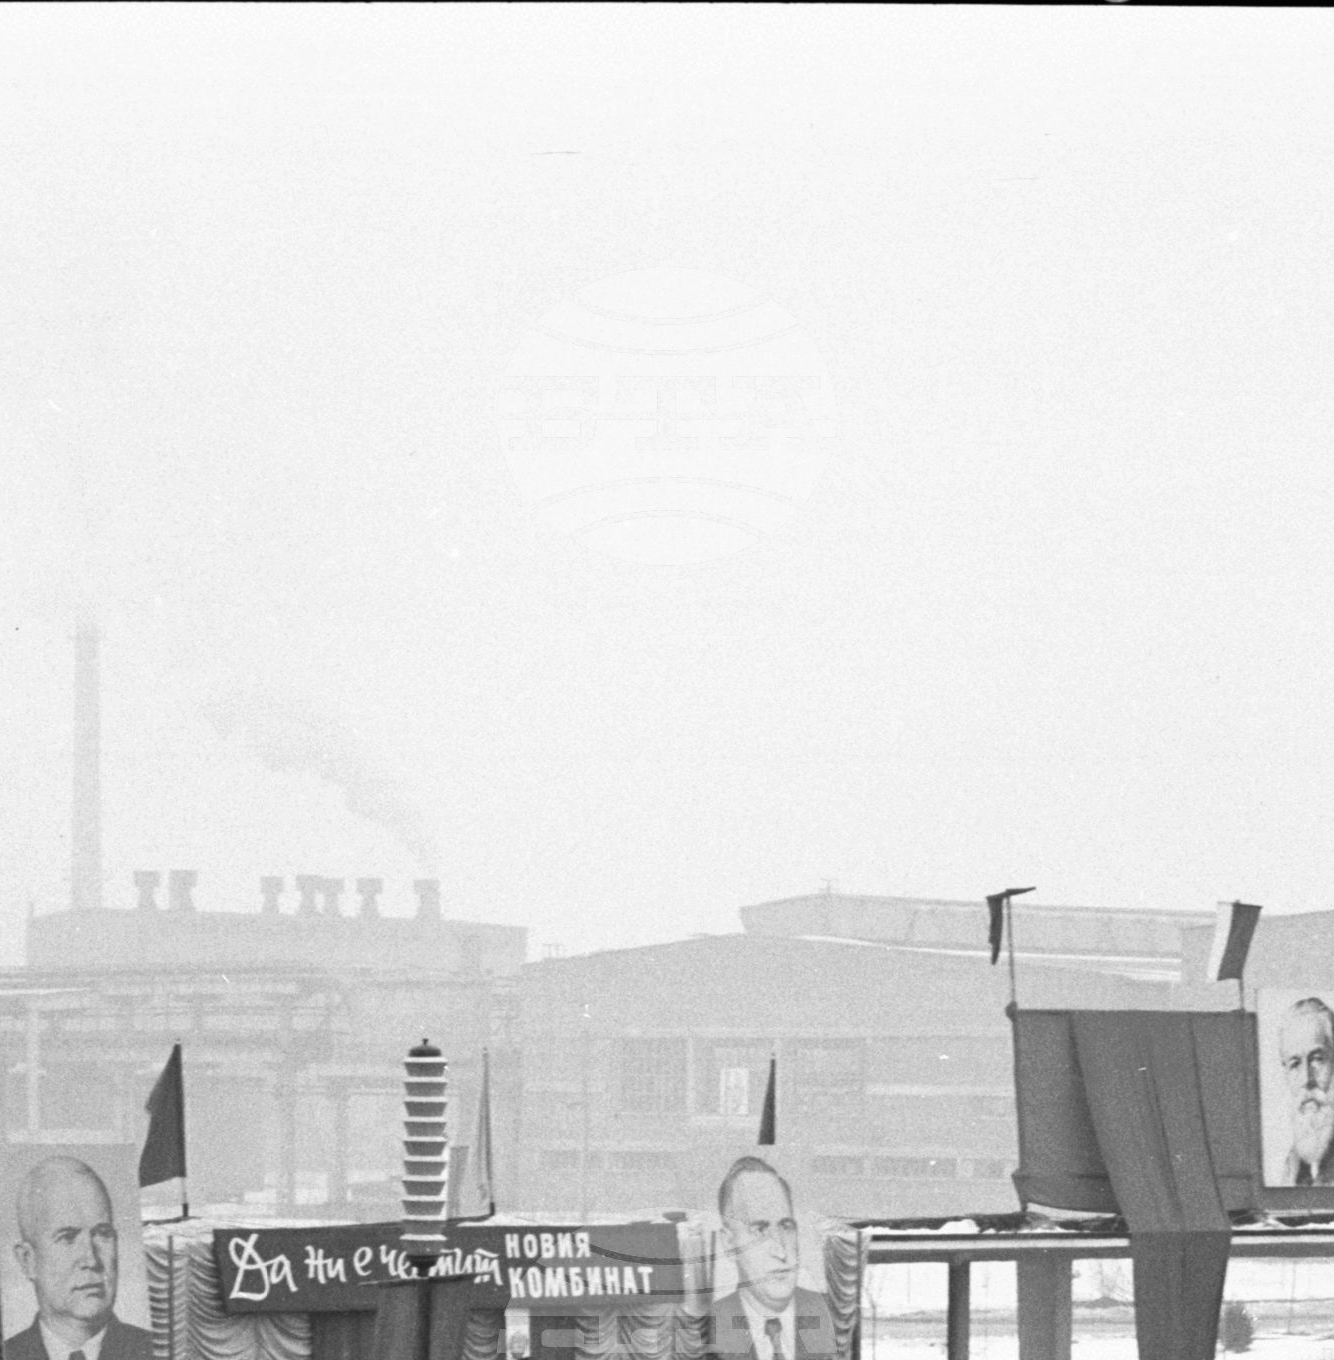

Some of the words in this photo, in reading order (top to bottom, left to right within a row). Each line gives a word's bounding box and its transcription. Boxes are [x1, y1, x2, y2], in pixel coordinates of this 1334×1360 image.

[505, 1232, 591, 1259] НОВИЯ
[228, 1233, 299, 1301] Да
[304, 1244, 347, 1284] ни
[379, 1244, 504, 1287] четит
[508, 1265, 654, 1299] КОМБИНАТ
